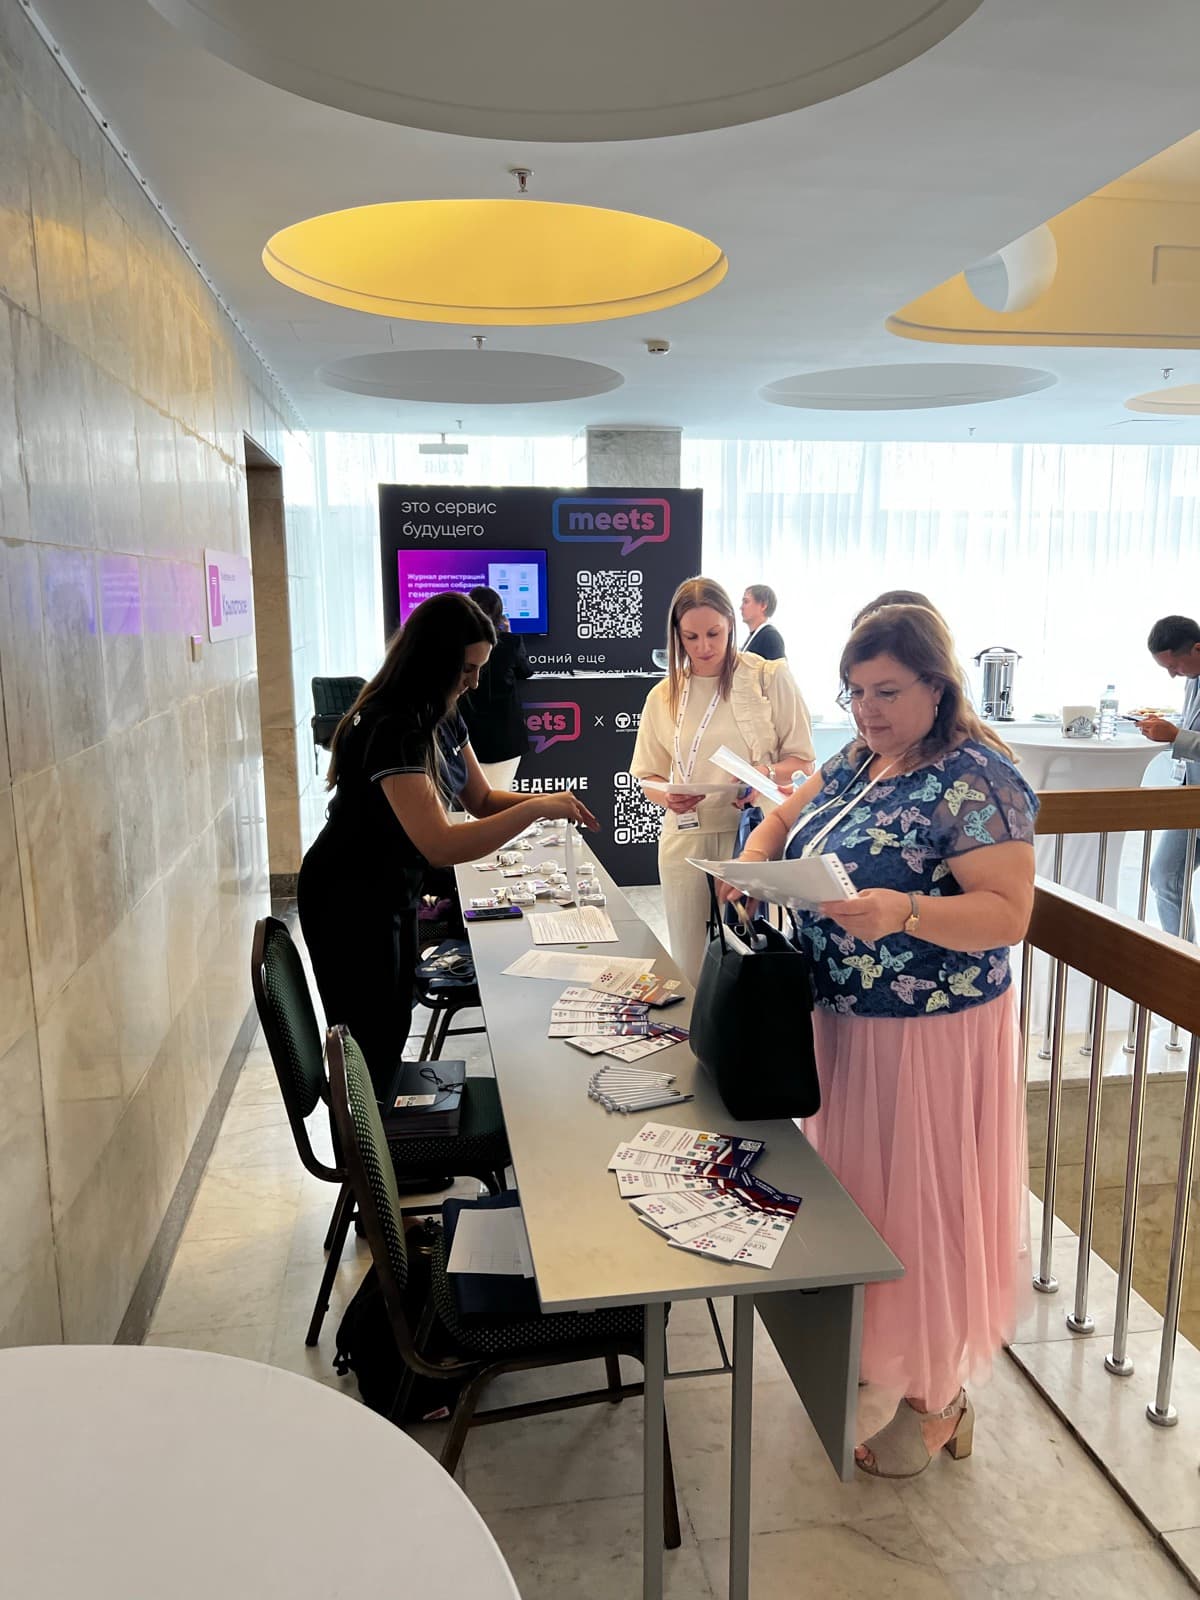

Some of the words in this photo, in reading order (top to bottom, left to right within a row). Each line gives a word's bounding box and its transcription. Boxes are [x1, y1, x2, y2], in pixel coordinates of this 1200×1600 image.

[401, 502, 431, 514] это
[435, 502, 497, 518] сервис
[568, 508, 656, 531] meets
[402, 521, 485, 540] будущего
[577, 654, 606, 665] еще
[524, 711, 567, 731] ets
[511, 776, 588, 793] ВЕДЕНИЕ
